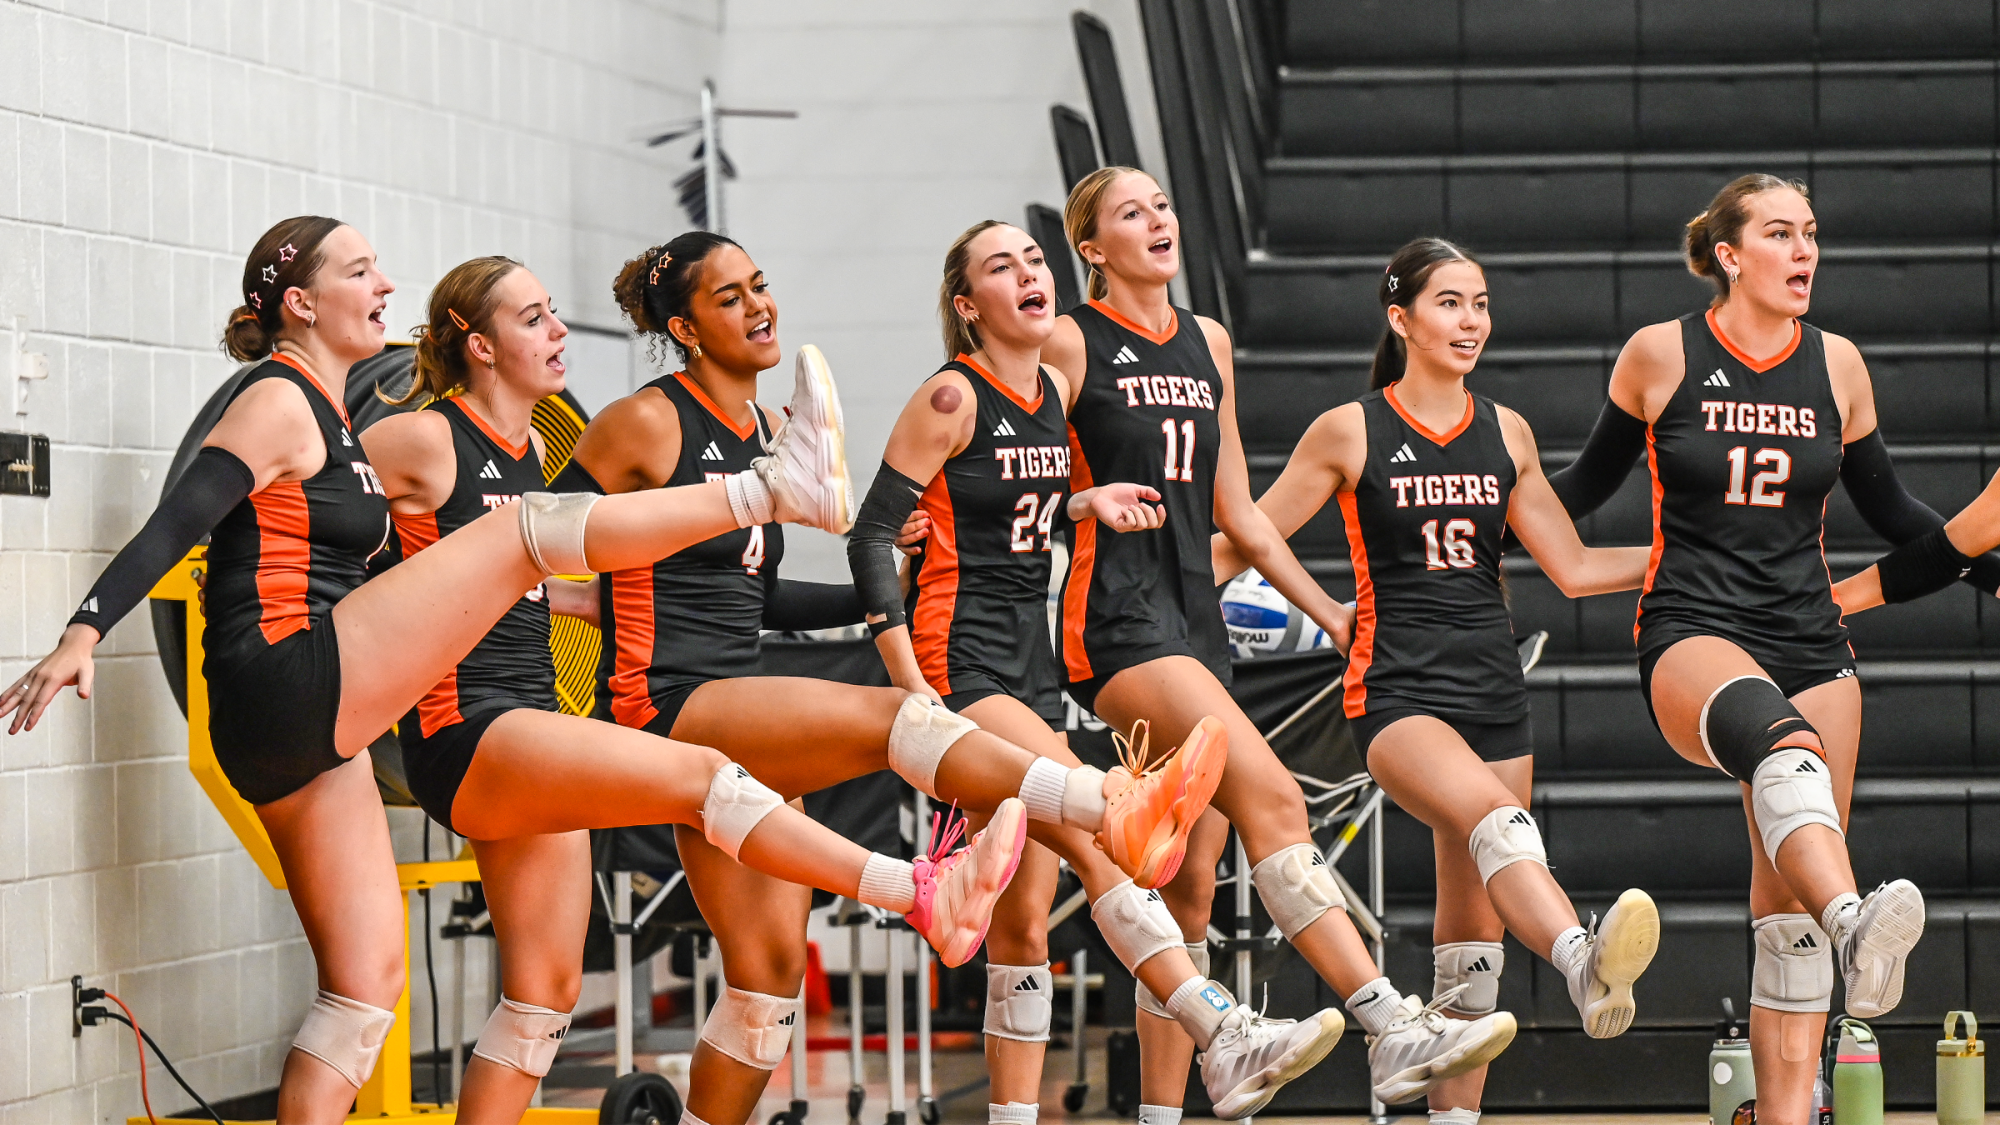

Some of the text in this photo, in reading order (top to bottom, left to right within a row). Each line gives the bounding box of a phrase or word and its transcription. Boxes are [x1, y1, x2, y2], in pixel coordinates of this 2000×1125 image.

[1116, 375, 1215, 411] TIGERS
[1701, 400, 1817, 438] TIGERS
[1161, 418, 1196, 483] 11
[1724, 445, 1792, 508] 12
[1390, 474, 1500, 508] TIGERS
[1010, 491, 1063, 553] 24
[1421, 518, 1477, 571] 16
[741, 524, 766, 576] 4
